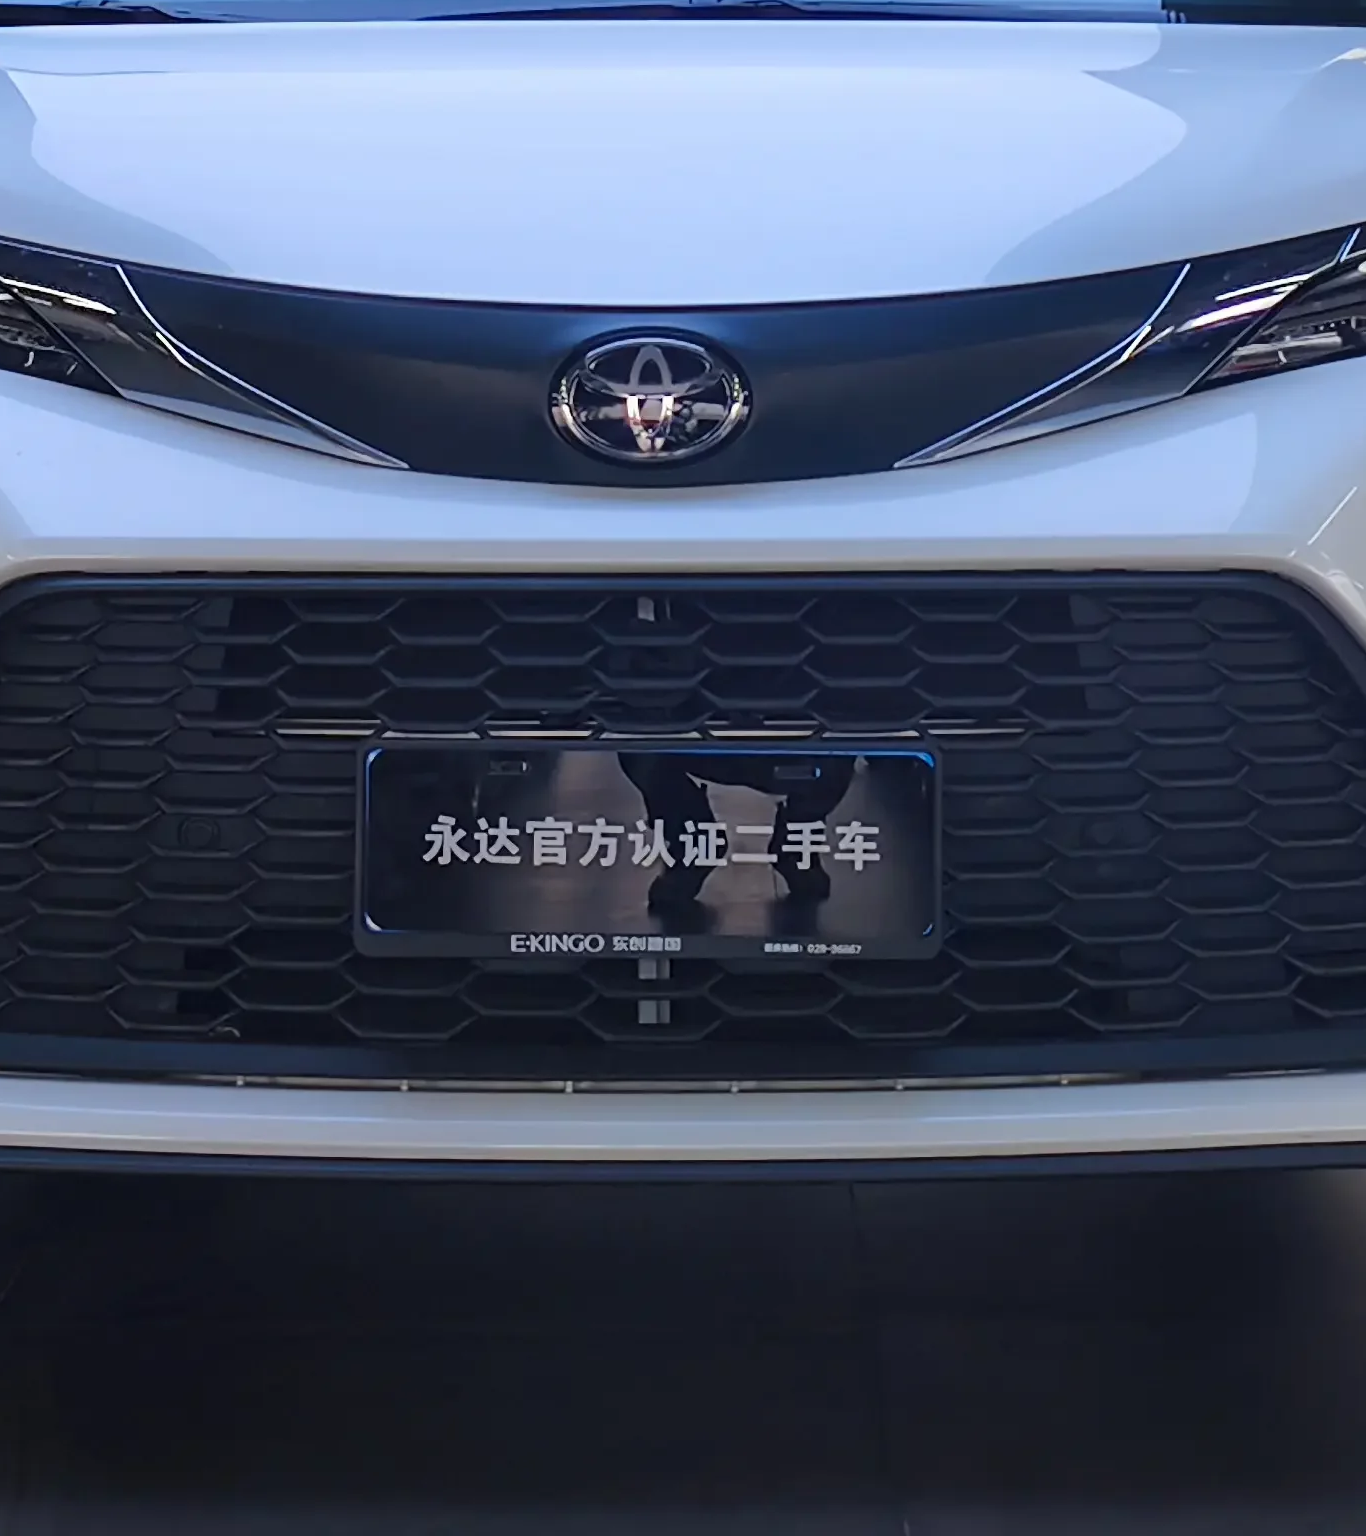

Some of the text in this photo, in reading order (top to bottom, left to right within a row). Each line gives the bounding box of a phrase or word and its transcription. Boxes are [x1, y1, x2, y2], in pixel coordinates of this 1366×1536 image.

[421, 814, 881, 871] 永达官方认证二手车
